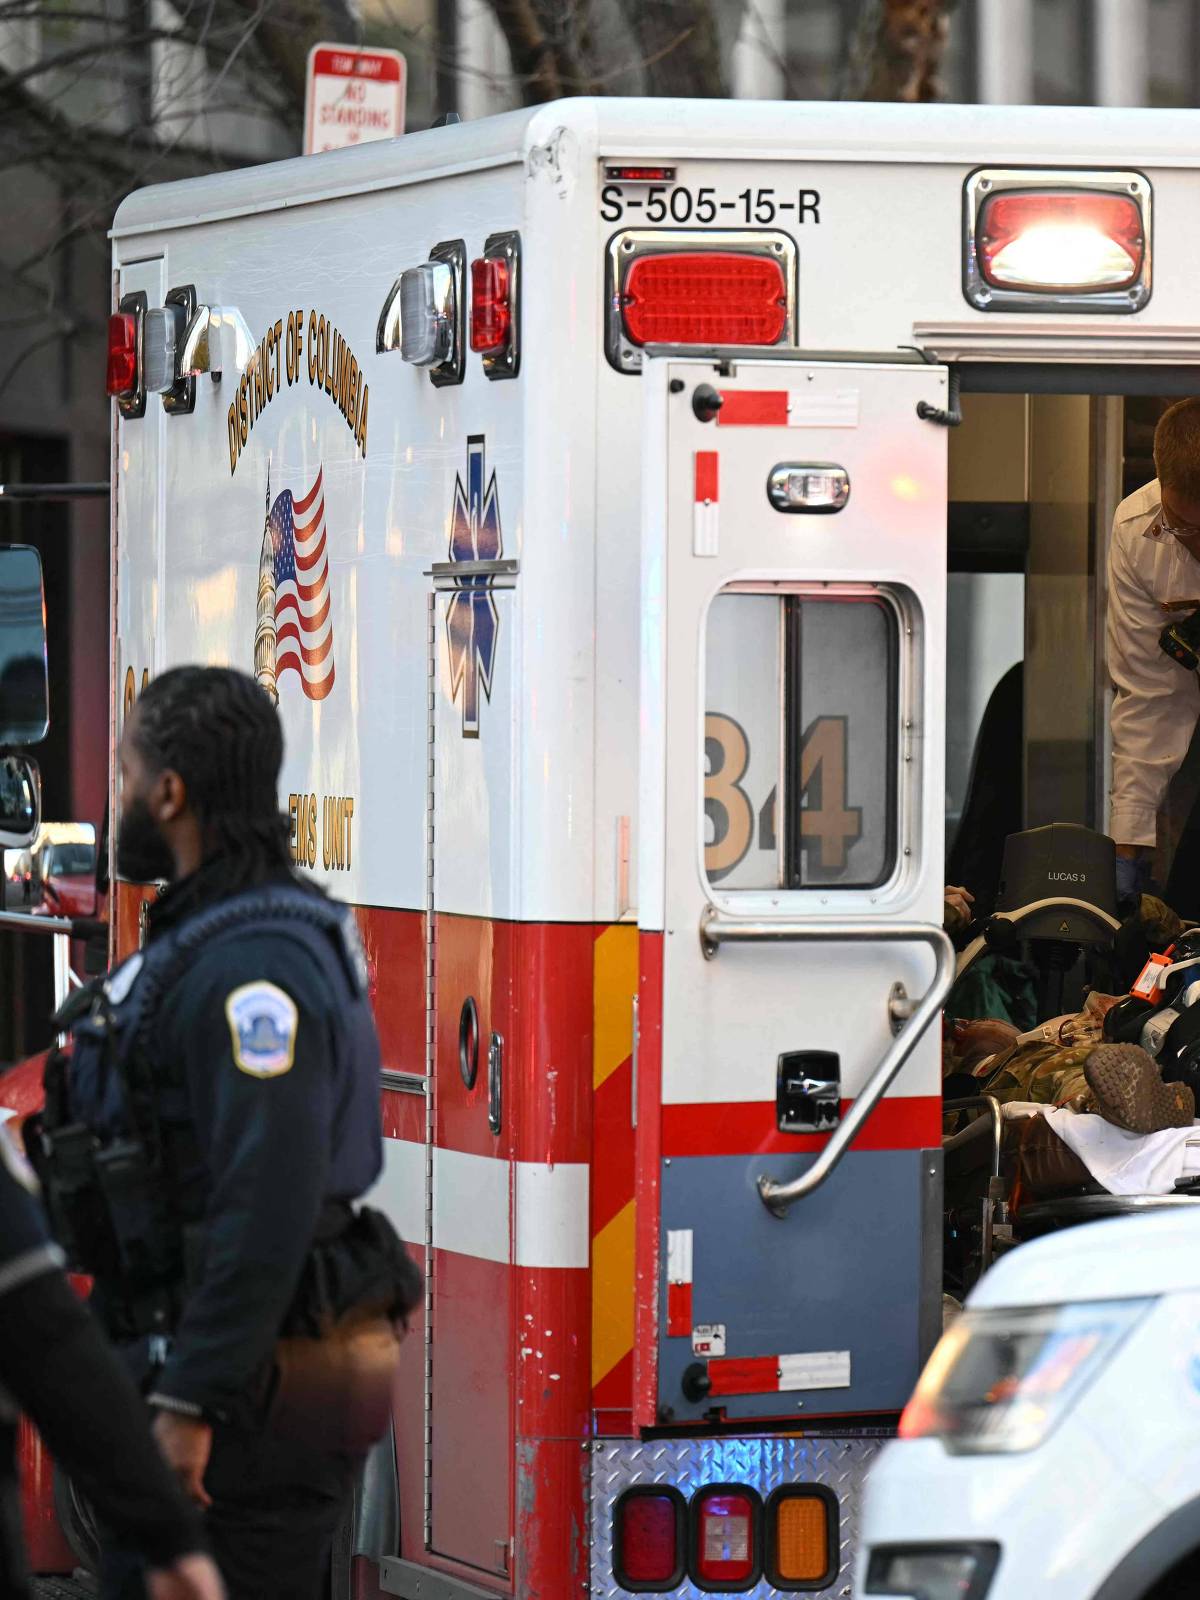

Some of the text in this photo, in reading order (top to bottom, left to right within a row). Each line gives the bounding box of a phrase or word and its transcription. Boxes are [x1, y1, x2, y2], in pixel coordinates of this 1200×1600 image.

[600, 185, 821, 224] S-505-15-R
[227, 309, 369, 477] DISTRICT OF COLUMBIA
[288, 793, 354, 872] EMS UNIT
[1048, 871, 1087, 882] LUCAS 3
